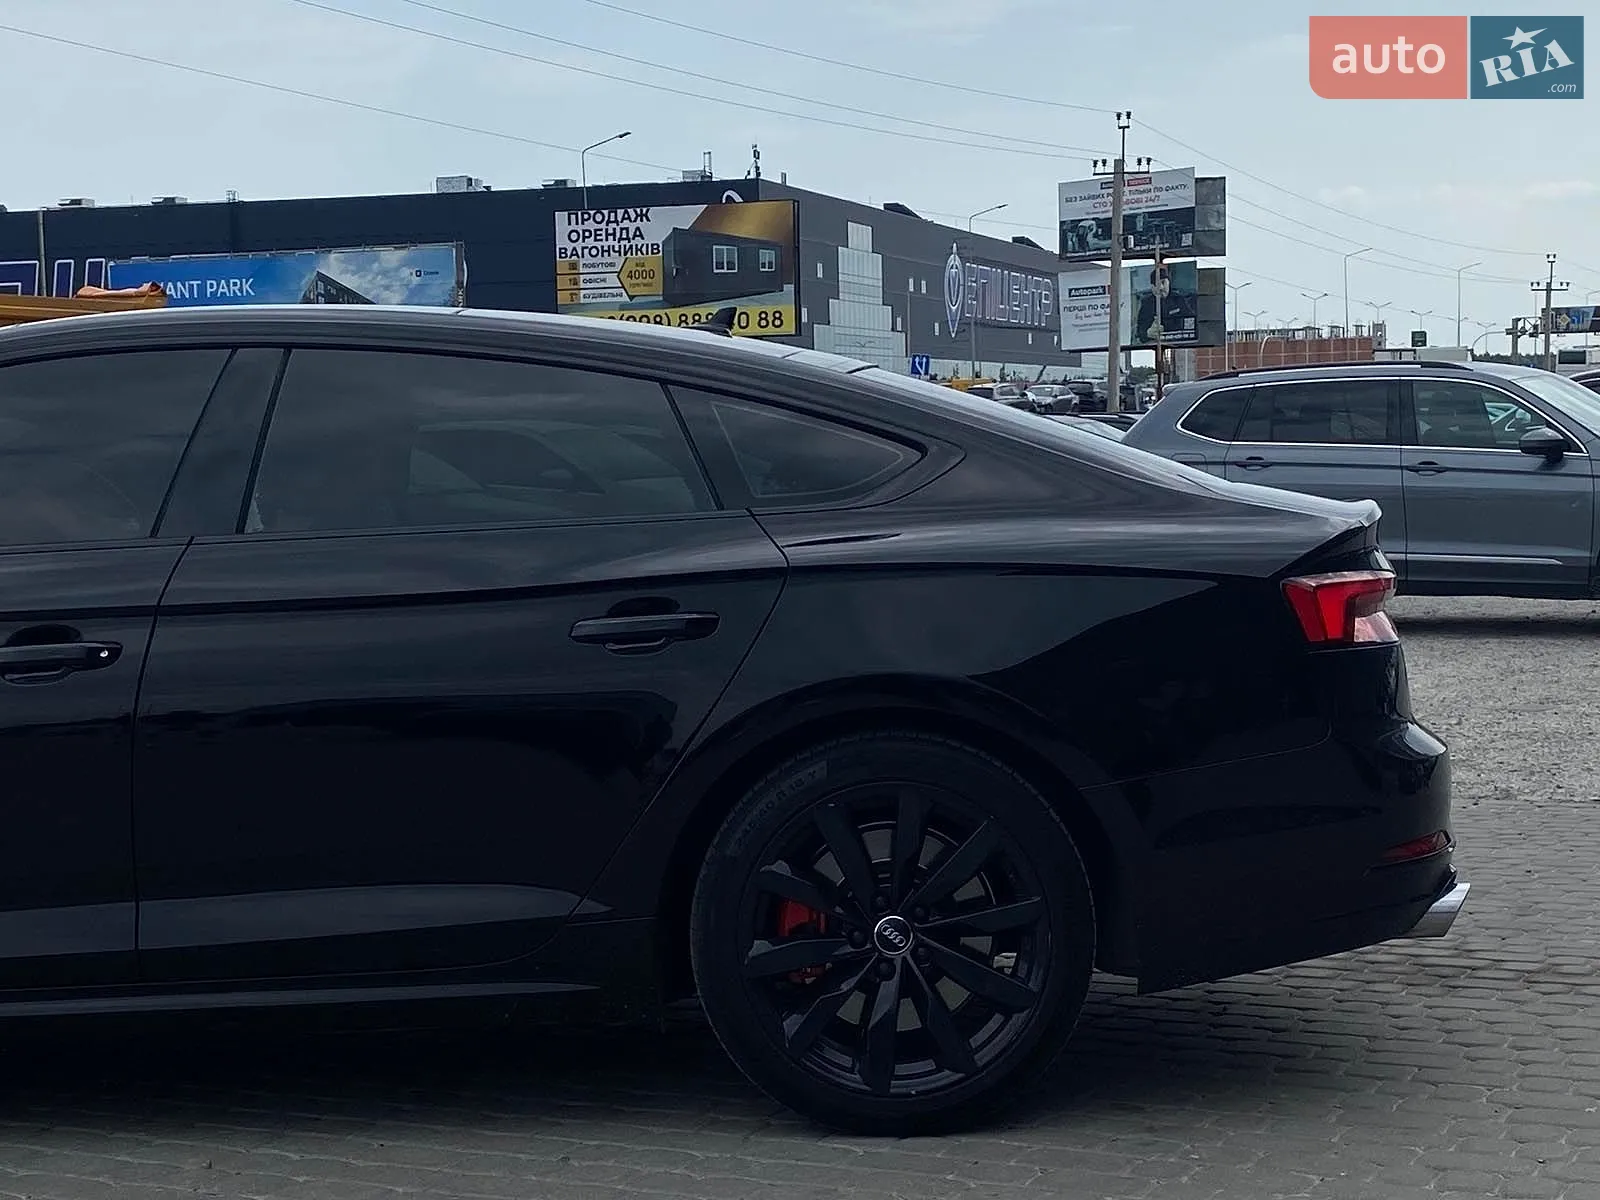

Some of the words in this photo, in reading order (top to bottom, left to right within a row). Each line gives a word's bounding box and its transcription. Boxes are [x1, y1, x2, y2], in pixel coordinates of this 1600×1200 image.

[1092, 200, 1108, 209] СТО
[567, 207, 651, 226] ПРОДАЖ
[567, 227, 645, 244] ОРЕНДА
[558, 243, 662, 260] ВАГОНЧИКІВ
[626, 269, 655, 280] 4000
[161, 280, 202, 299] ANT
[206, 278, 255, 298] PARK
[965, 263, 1053, 326] ЕПІЦЕНТР
[1070, 286, 1105, 297] Autopark
[1063, 303, 1087, 313] ПЕРШІ
[1087, 303, 1099, 311] ПО
[757, 310, 784, 329] 88
